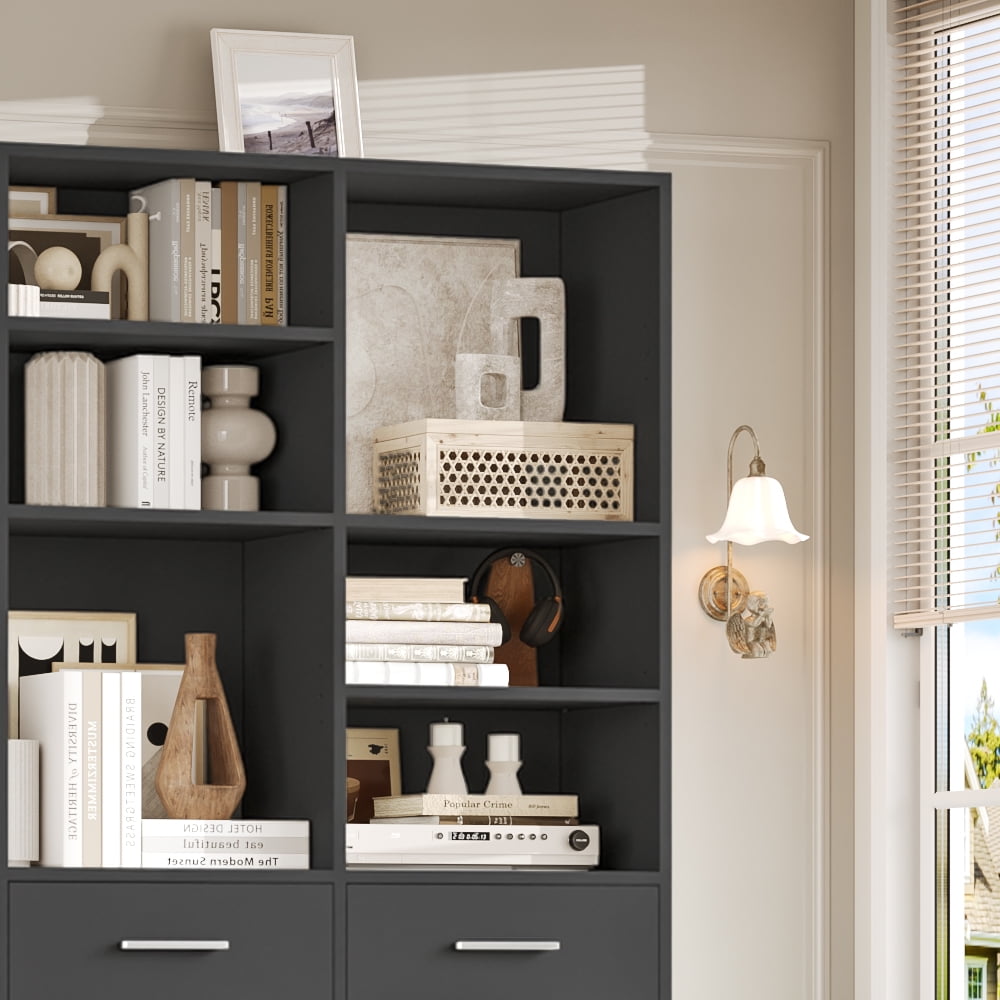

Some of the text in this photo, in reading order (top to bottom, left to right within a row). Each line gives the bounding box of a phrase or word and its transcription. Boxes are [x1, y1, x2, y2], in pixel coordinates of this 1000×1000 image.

[140, 371, 151, 391] John
[188, 381, 199, 423] Remote
[141, 392, 151, 438] Lanchester
[157, 387, 166, 483] DESIGN BY NATURE
[443, 800, 513, 811] Popular Crime
